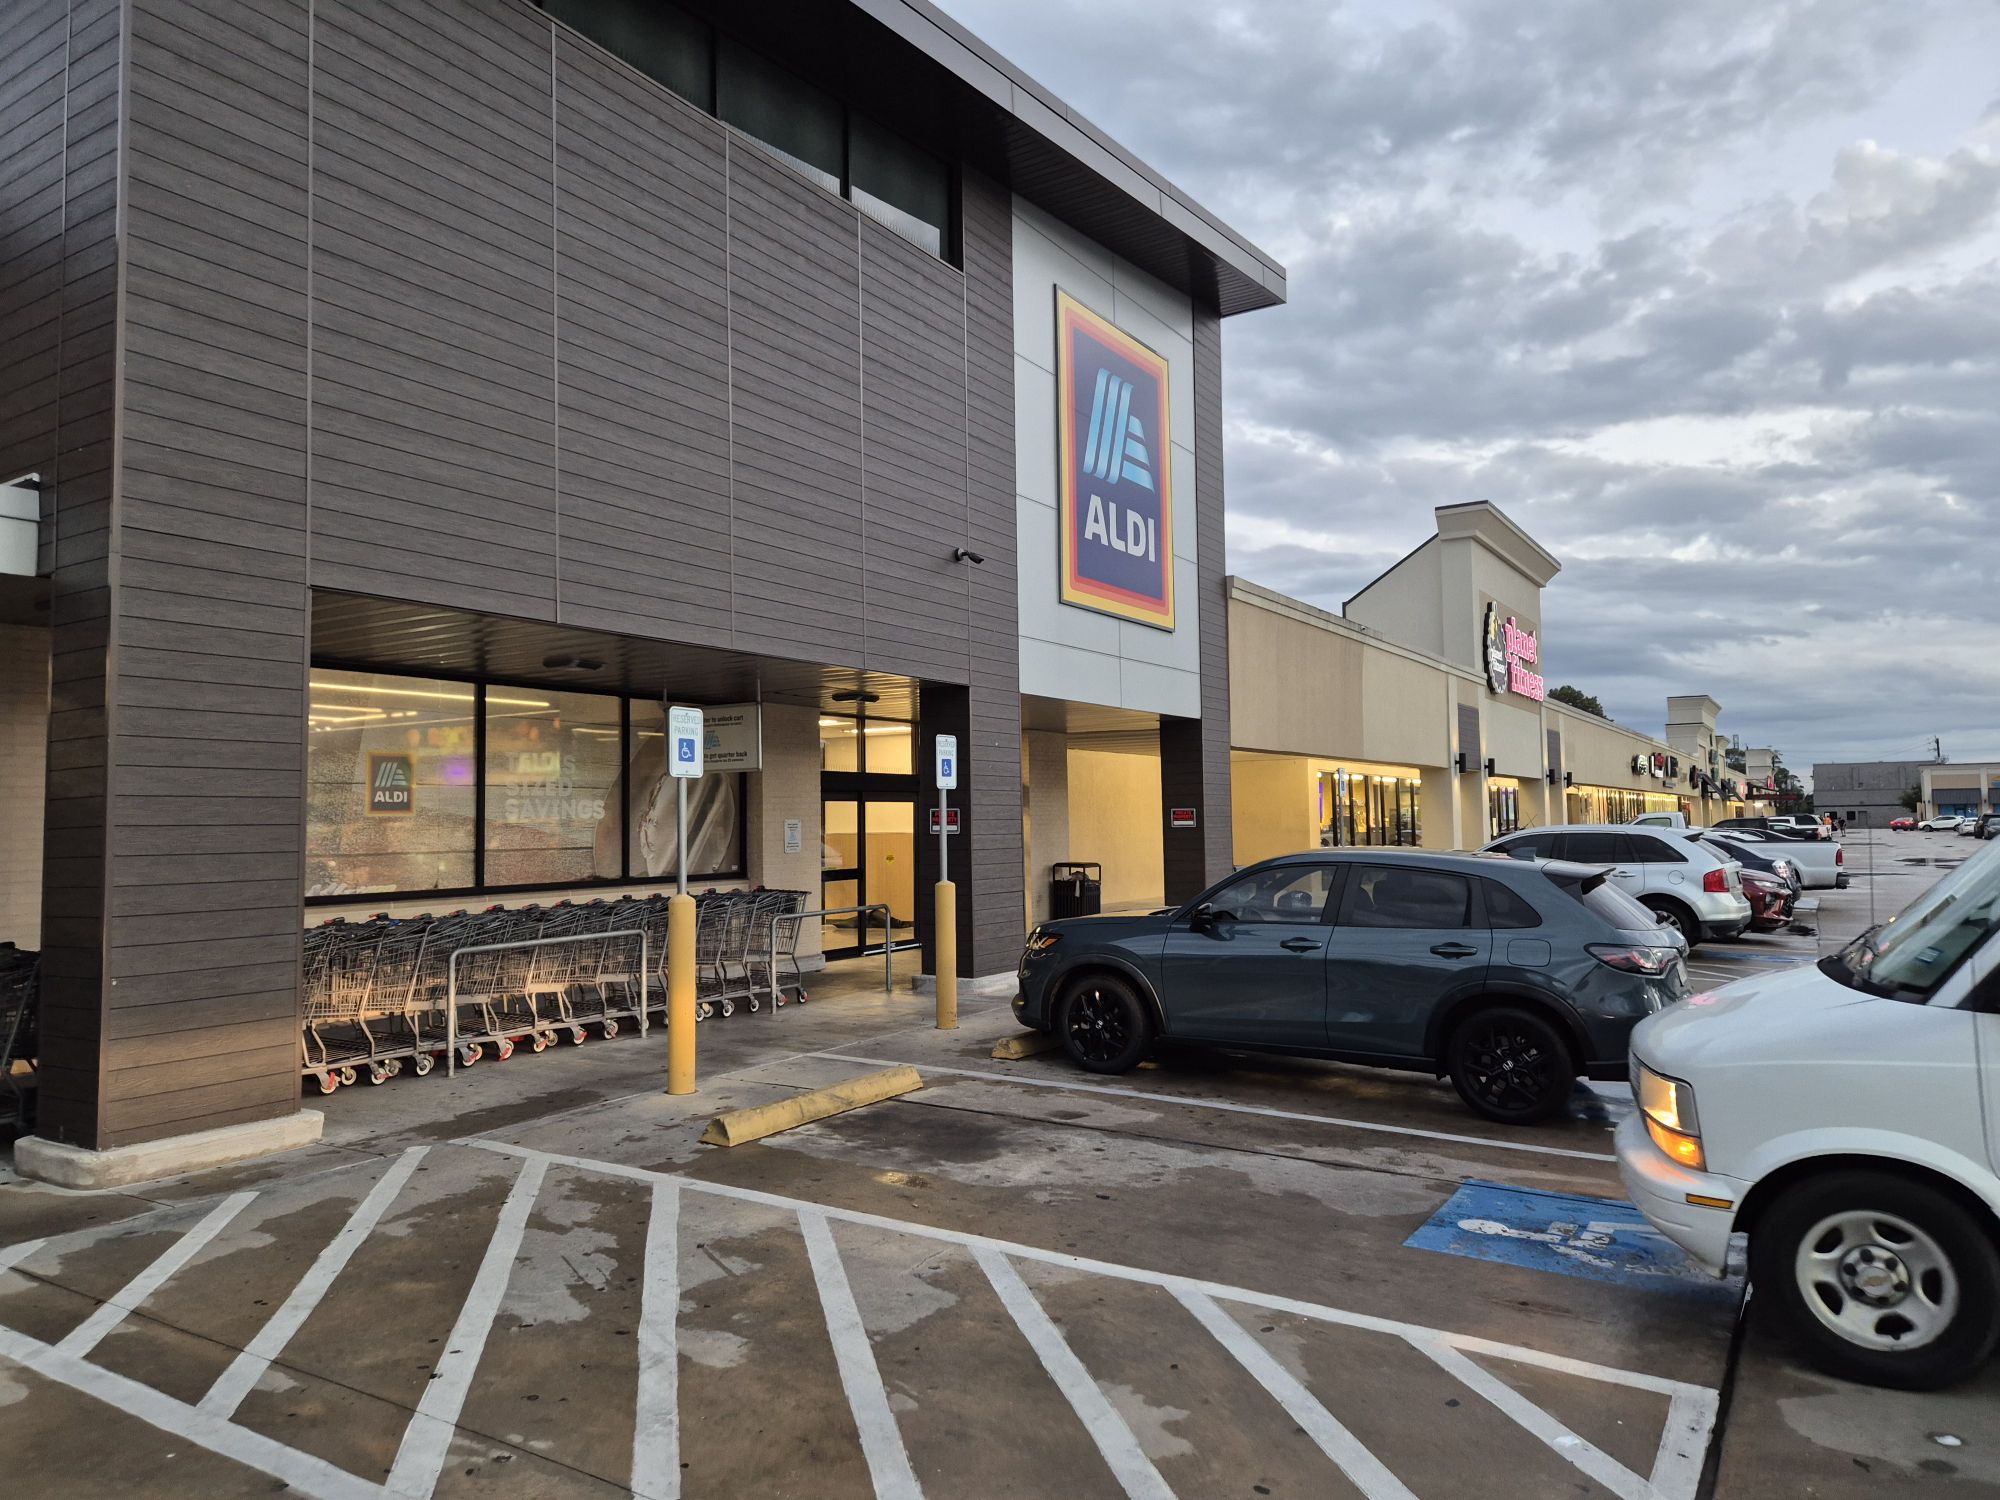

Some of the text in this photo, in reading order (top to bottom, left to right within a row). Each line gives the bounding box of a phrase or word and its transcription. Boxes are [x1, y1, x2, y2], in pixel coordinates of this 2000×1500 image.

[1084, 494, 1156, 562] ALDI
[672, 714, 702, 725] RESERVED
[674, 726, 699, 736] PARKING
[505, 777, 572, 797] SIZED
[374, 791, 408, 803] ALDI
[504, 798, 605, 820] SAVINGS
